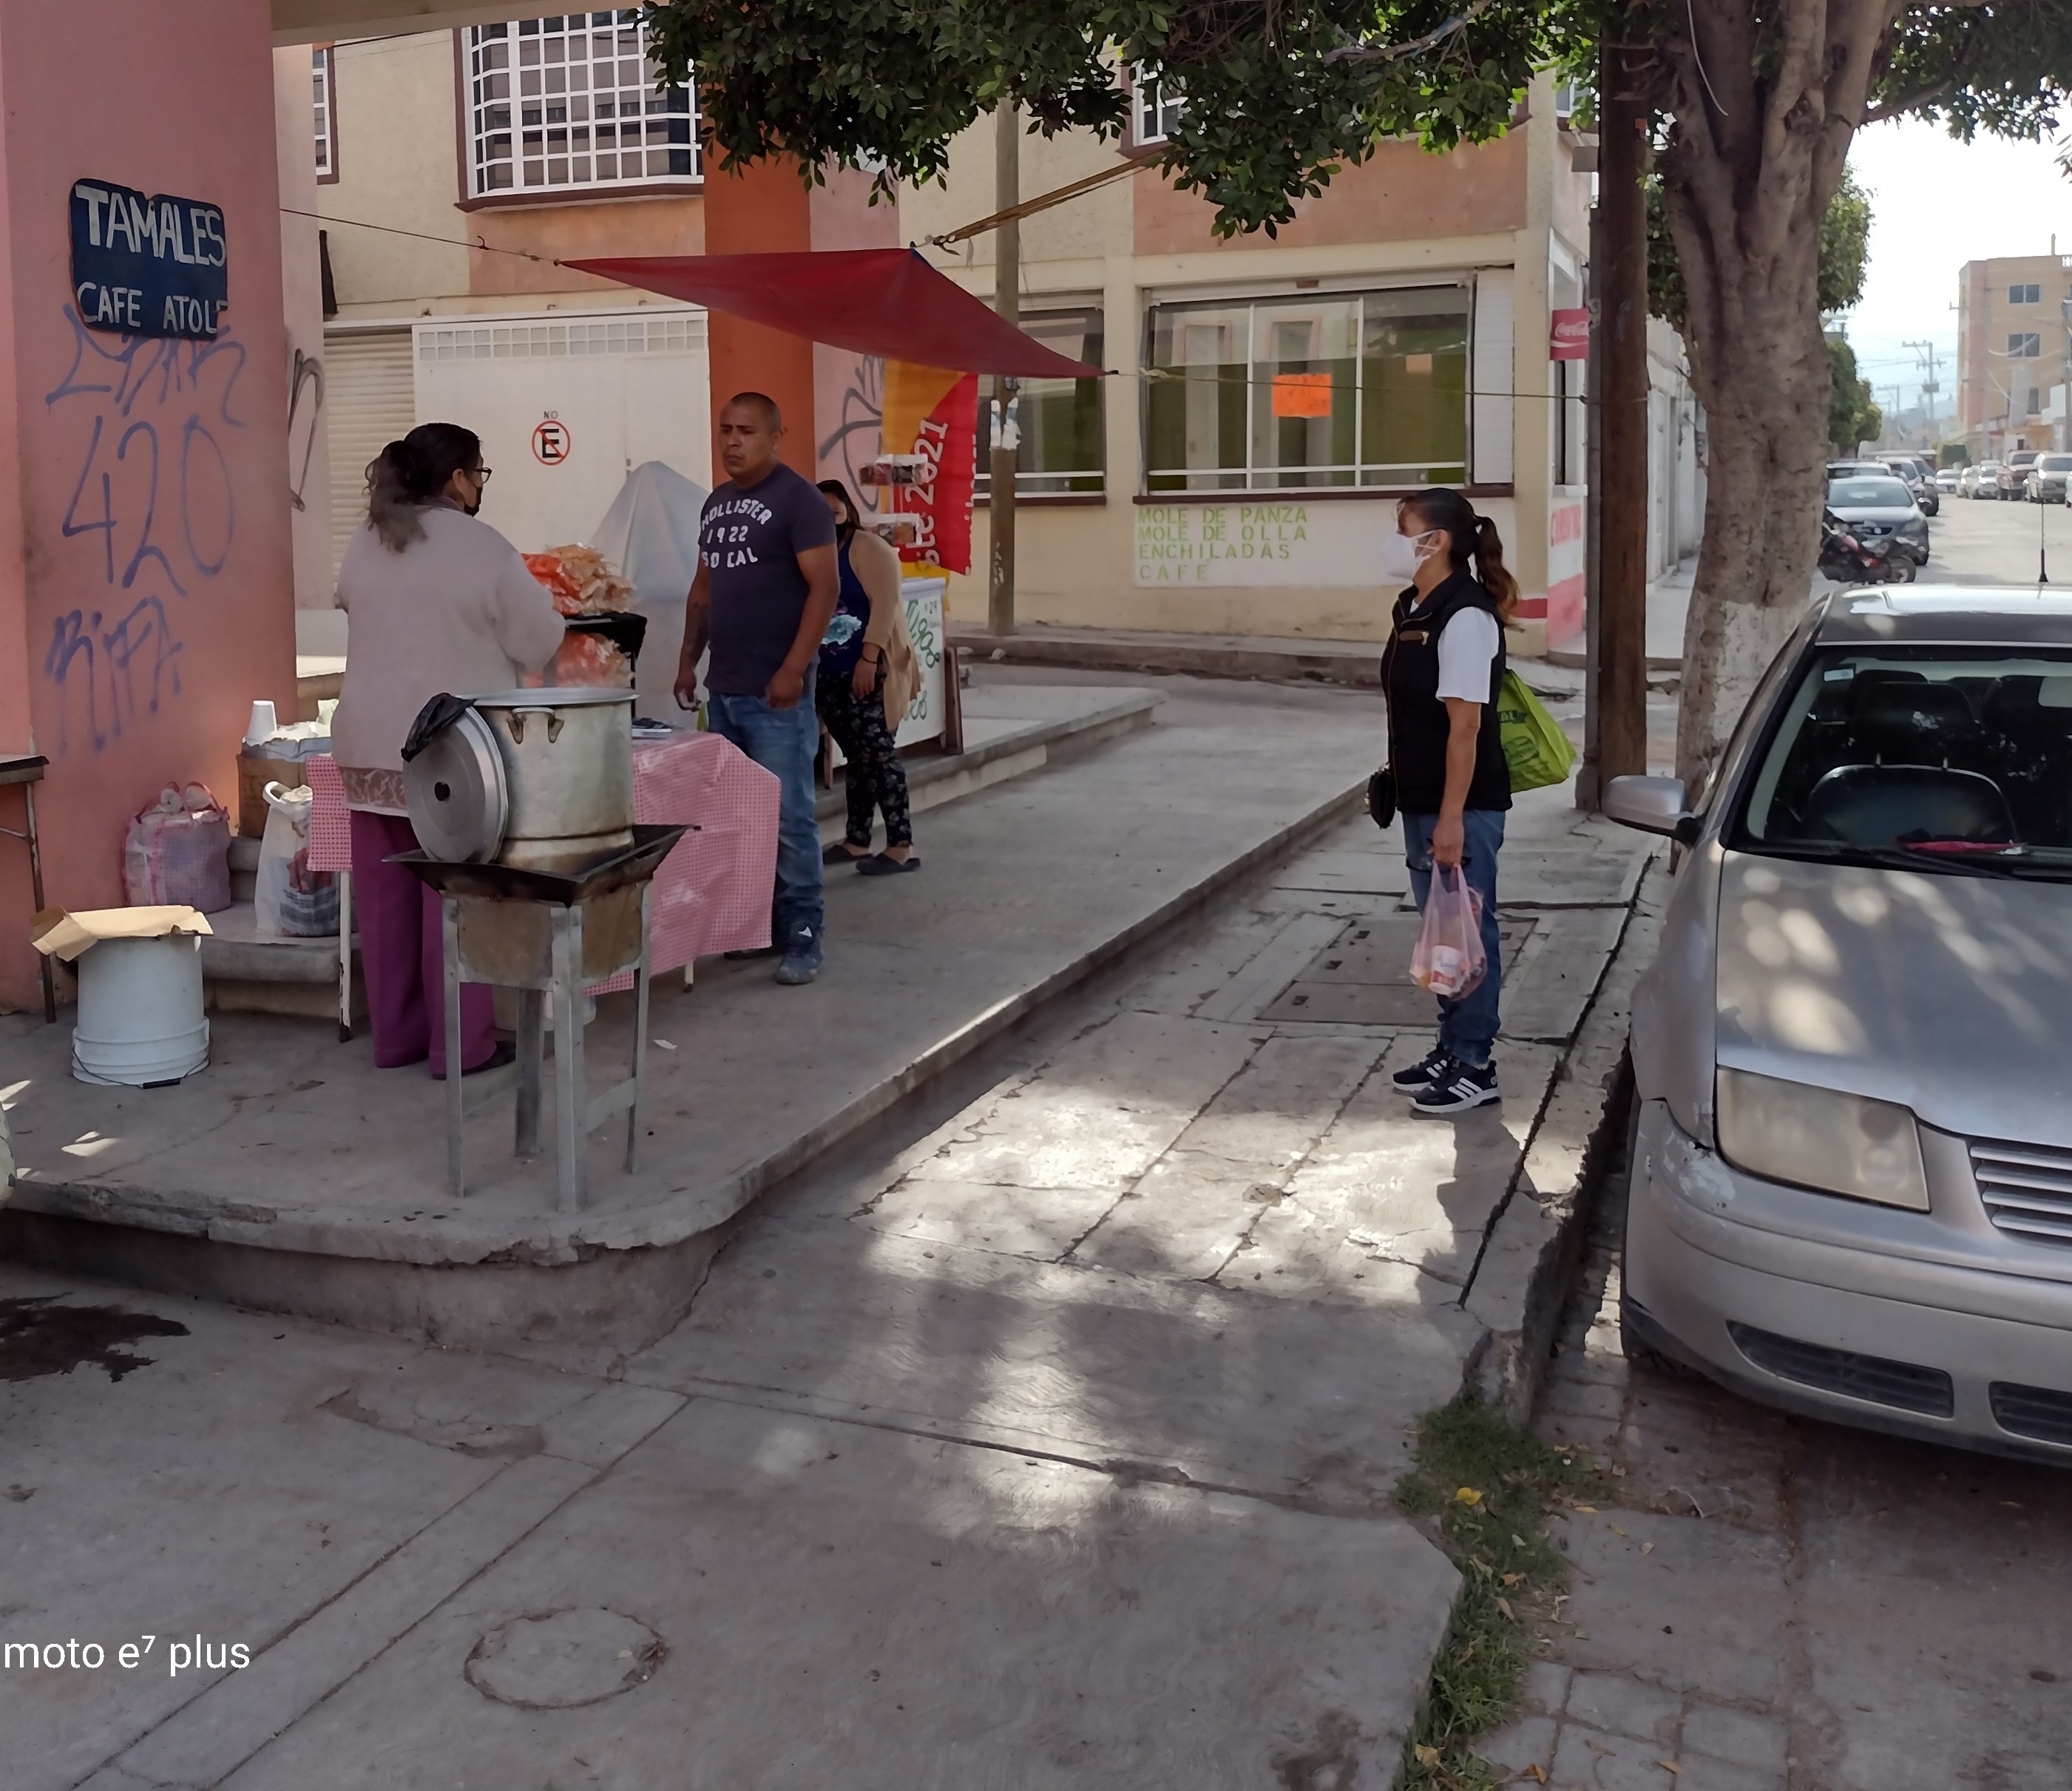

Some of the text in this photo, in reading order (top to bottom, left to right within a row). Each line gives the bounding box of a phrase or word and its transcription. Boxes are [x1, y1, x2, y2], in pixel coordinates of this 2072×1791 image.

[75, 184, 226, 267] TAMALES
[78, 282, 143, 328] CAFE
[544, 410, 558, 419] NO
[62, 416, 233, 596] 420
[702, 498, 772, 531] HOLLISTER
[1137, 507, 1307, 524] MOLE DE PANZA
[707, 525, 748, 544] 1922
[1137, 525, 1307, 541] MOLE DE OLLA
[702, 547, 758, 568] SO CAL
[1139, 544, 1290, 559] ENCHILADAS
[1140, 565, 1208, 580] CAFE
